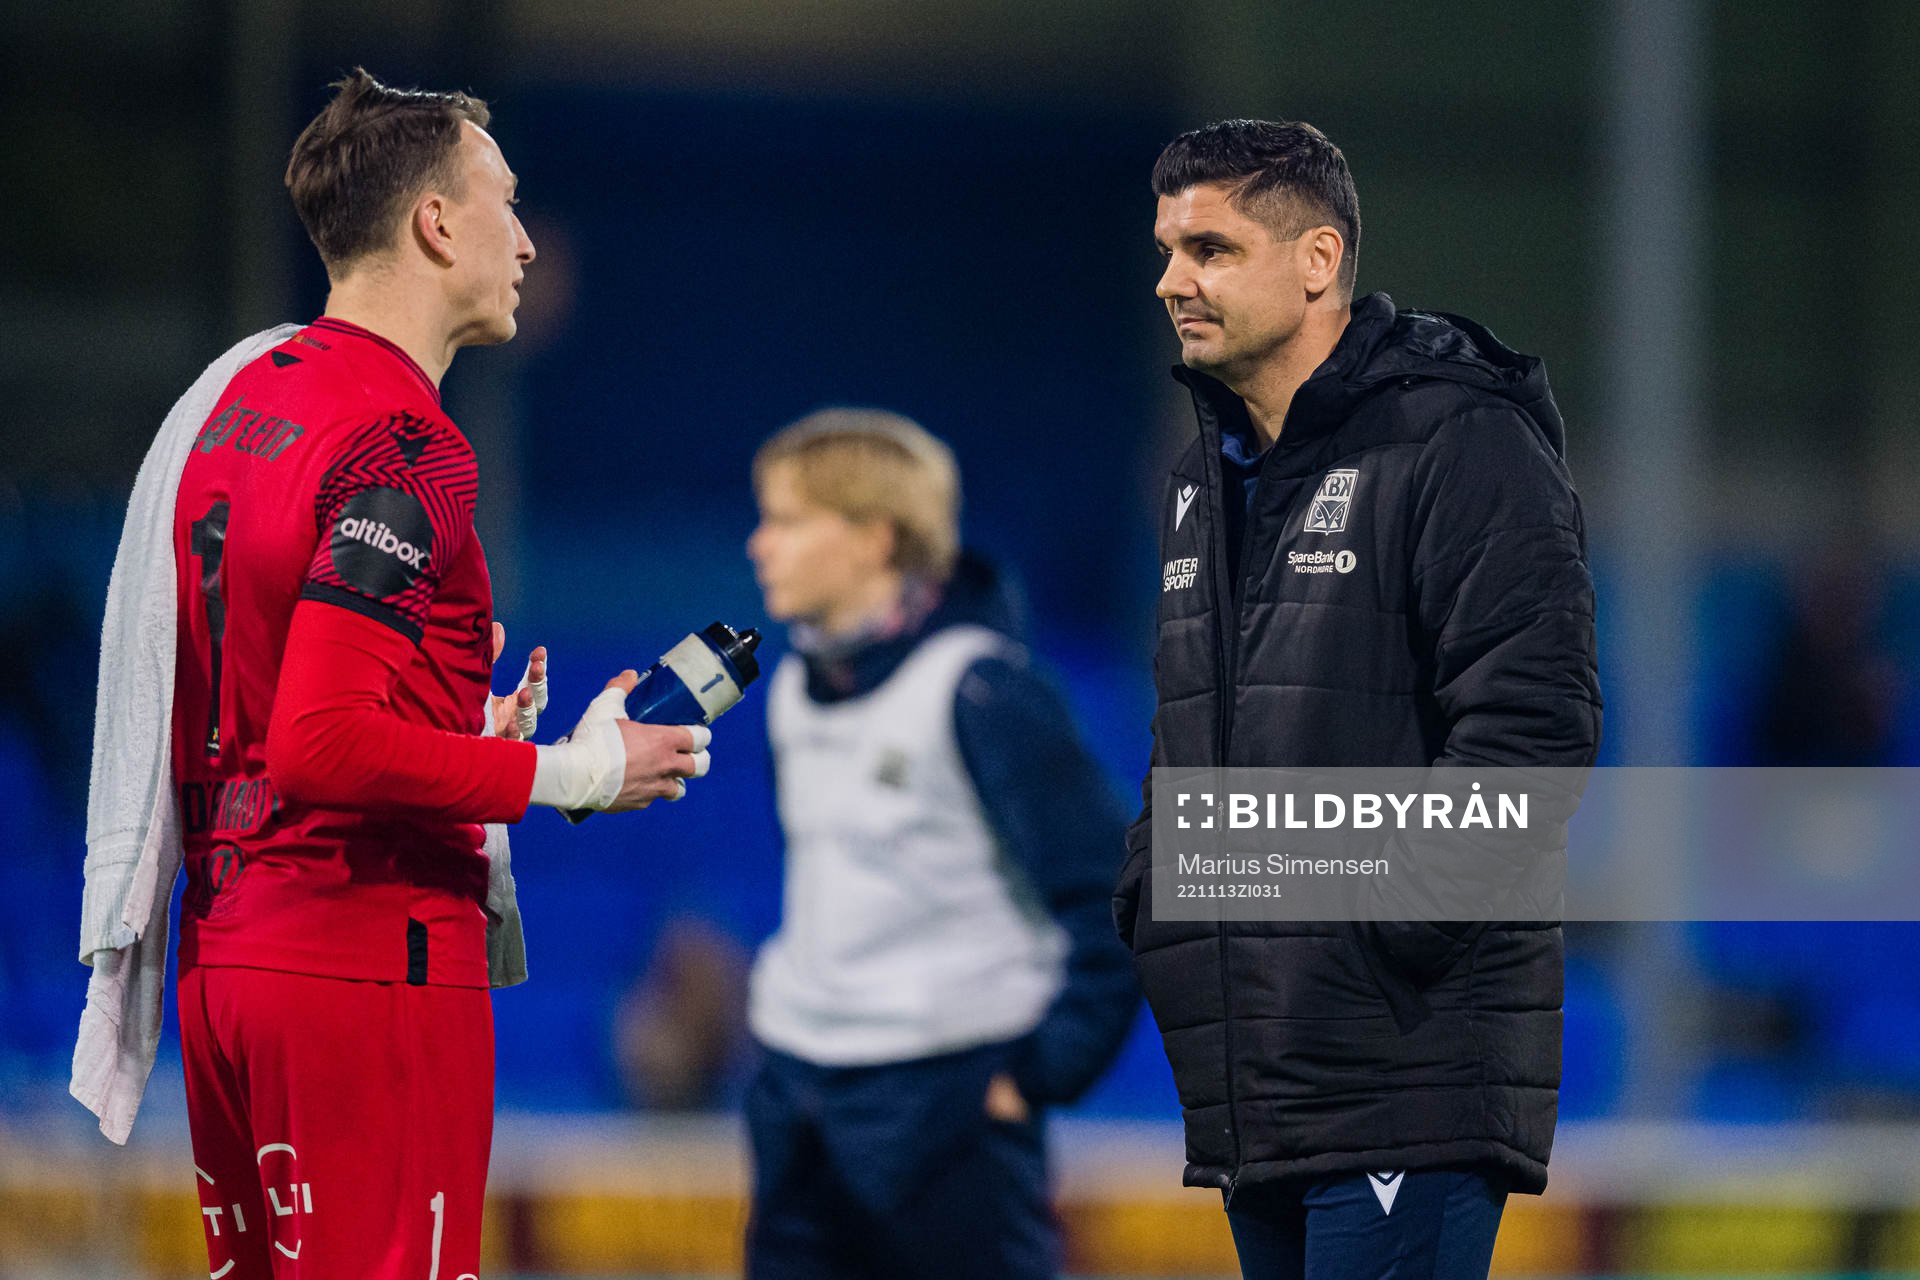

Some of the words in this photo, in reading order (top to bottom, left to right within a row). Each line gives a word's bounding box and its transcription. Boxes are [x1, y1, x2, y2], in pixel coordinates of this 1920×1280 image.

[340, 517, 425, 570] altibox
[1165, 557, 1199, 577] INTER
[1287, 550, 1335, 565] SpareBank
[1163, 572, 1197, 593] SPORT
